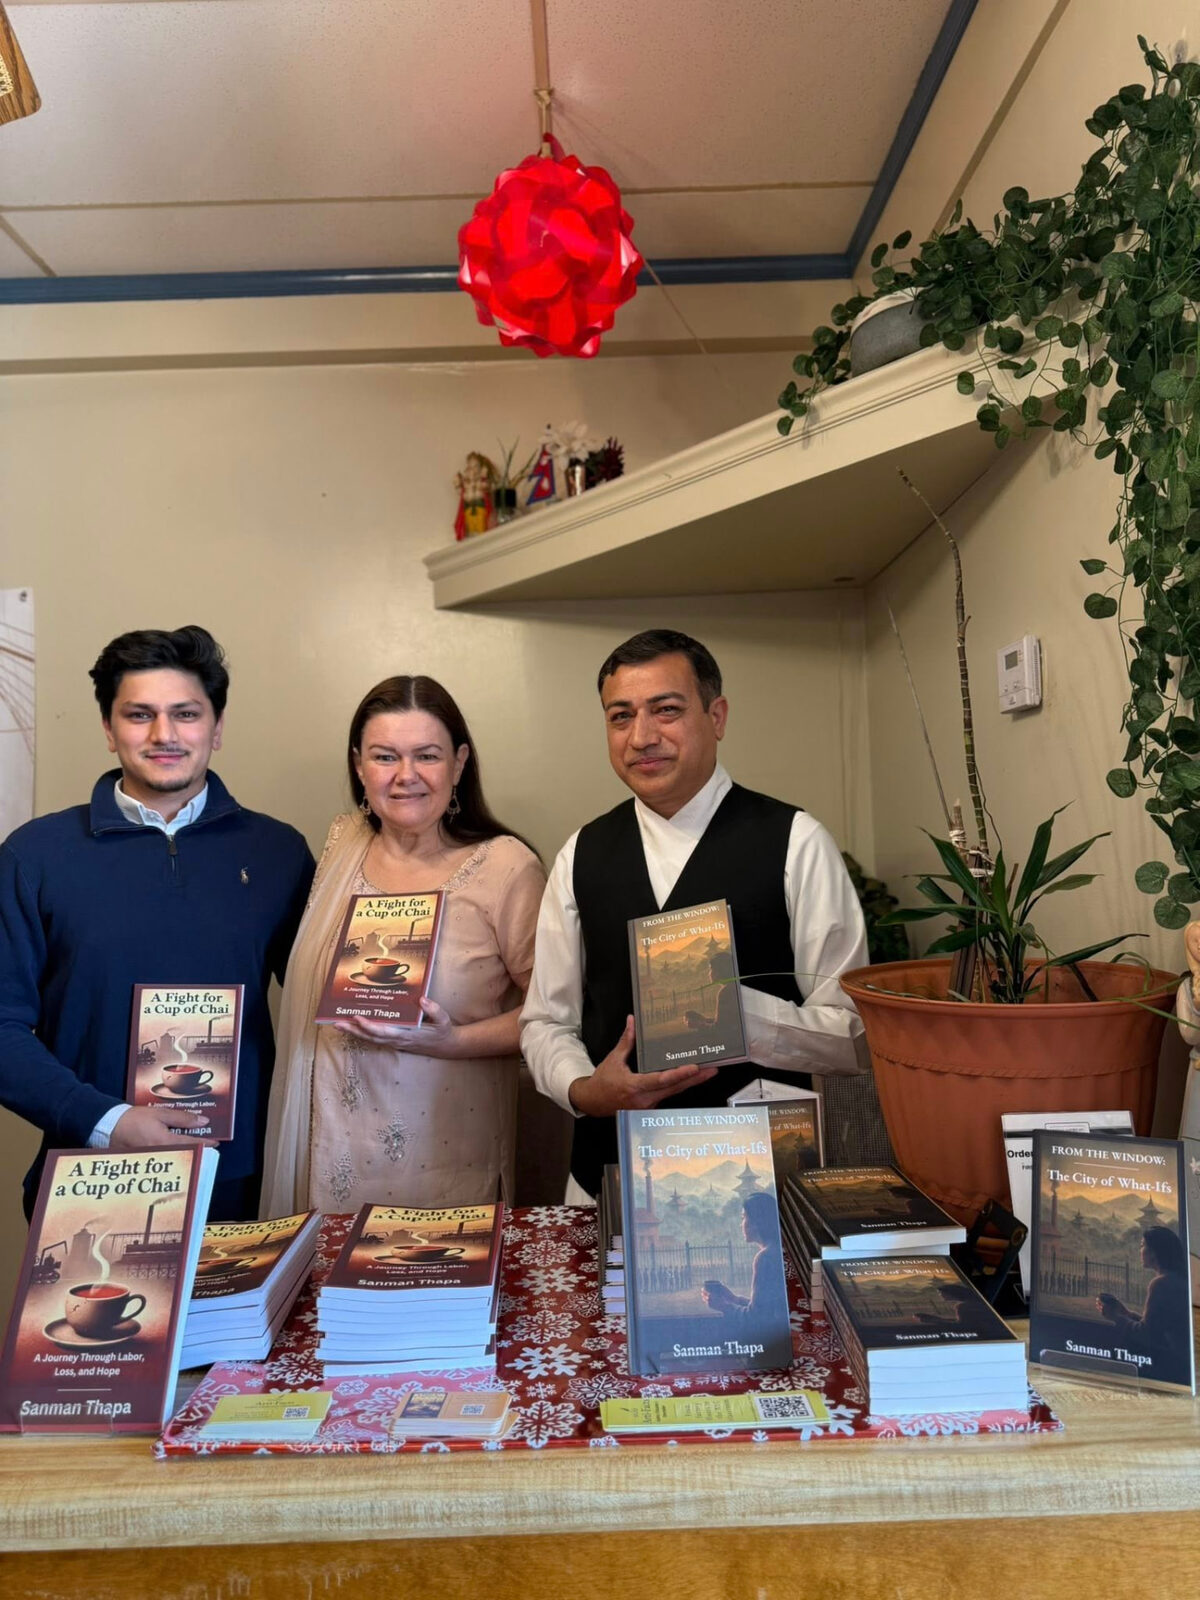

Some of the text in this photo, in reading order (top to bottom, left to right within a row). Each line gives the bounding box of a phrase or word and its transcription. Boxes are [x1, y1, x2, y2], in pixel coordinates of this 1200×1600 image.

[377, 899, 406, 910] Fight
[410, 898, 426, 906] for
[366, 908, 388, 920] Cup
[391, 908, 404, 916] of
[404, 907, 430, 916] Chai
[642, 918, 664, 928] FROM
[666, 914, 682, 922] THE
[640, 920, 725, 946] The City of What-Ifs
[151, 992, 223, 1004] A Fight for
[154, 1004, 180, 1016] Cup
[184, 1004, 198, 1014] of
[200, 1004, 229, 1014] Chai
[336, 1006, 400, 1018] Sanman Thapa
[665, 1044, 725, 1060] Sanman Thapa
[641, 1114, 759, 1127] FROM THE WINDOW:
[638, 1141, 767, 1160] The City of What-Ifs
[1052, 1146, 1166, 1165] FROM THE WINDOW:
[68, 1158, 173, 1180] A Fight for
[55, 1176, 181, 1200] a Cup of Chai
[1047, 1169, 1172, 1193] The City of What-Ifs
[673, 1341, 764, 1357] Sanman Thapa
[1066, 1340, 1152, 1367] Sanman Thapa
[34, 1352, 145, 1364] A Journey Through Labor,
[54, 1367, 120, 1377] Loss, and Hope
[20, 1400, 132, 1418] Sanman Thapa
